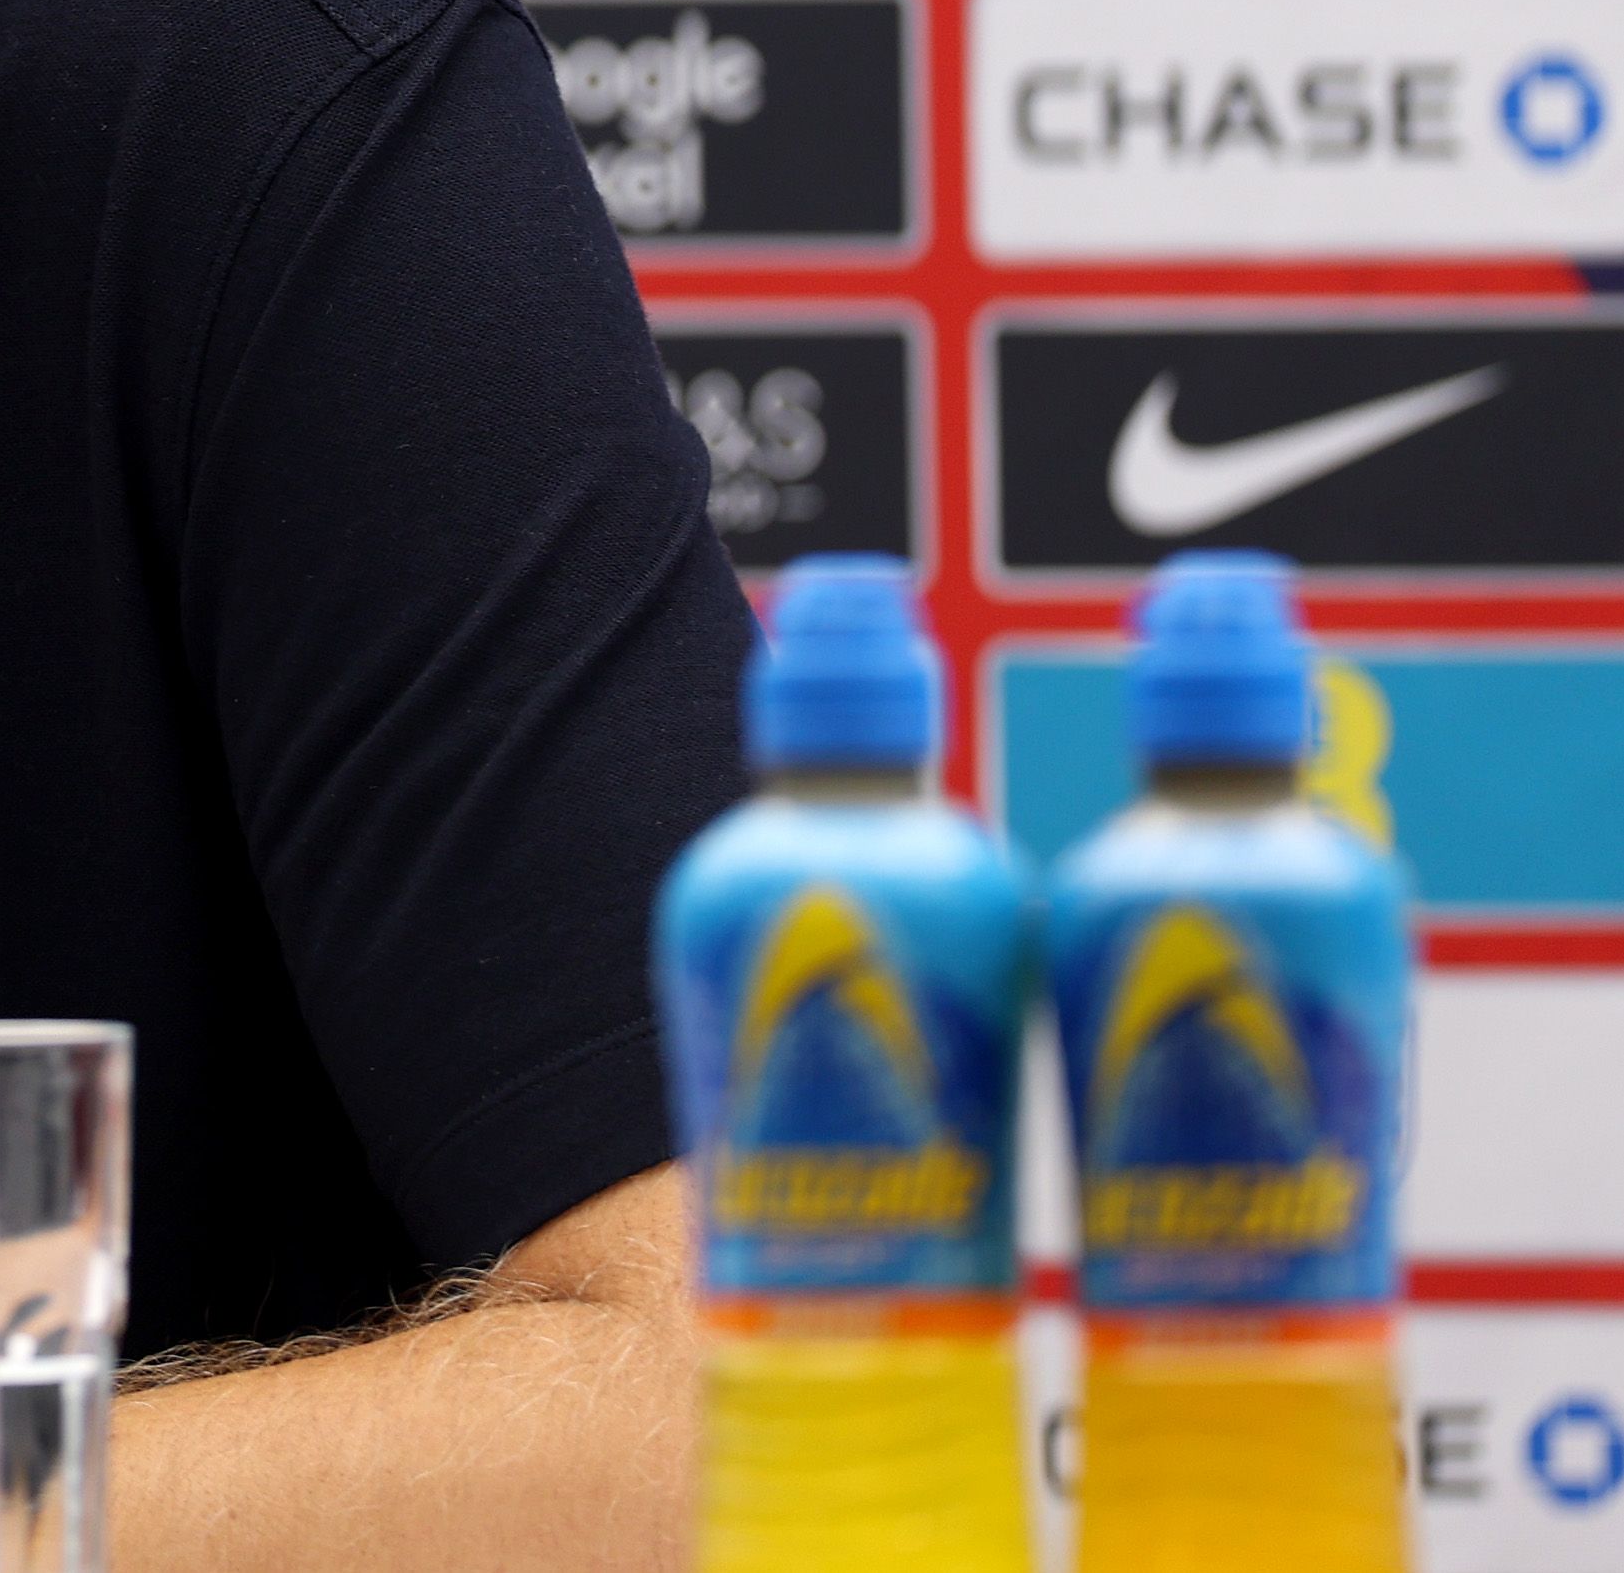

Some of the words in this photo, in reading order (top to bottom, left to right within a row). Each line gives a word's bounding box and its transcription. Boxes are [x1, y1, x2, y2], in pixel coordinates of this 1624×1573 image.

[550, 6, 766, 142] ogle
[1009, 62, 1460, 166] CHASE
[663, 368, 825, 481] &S
